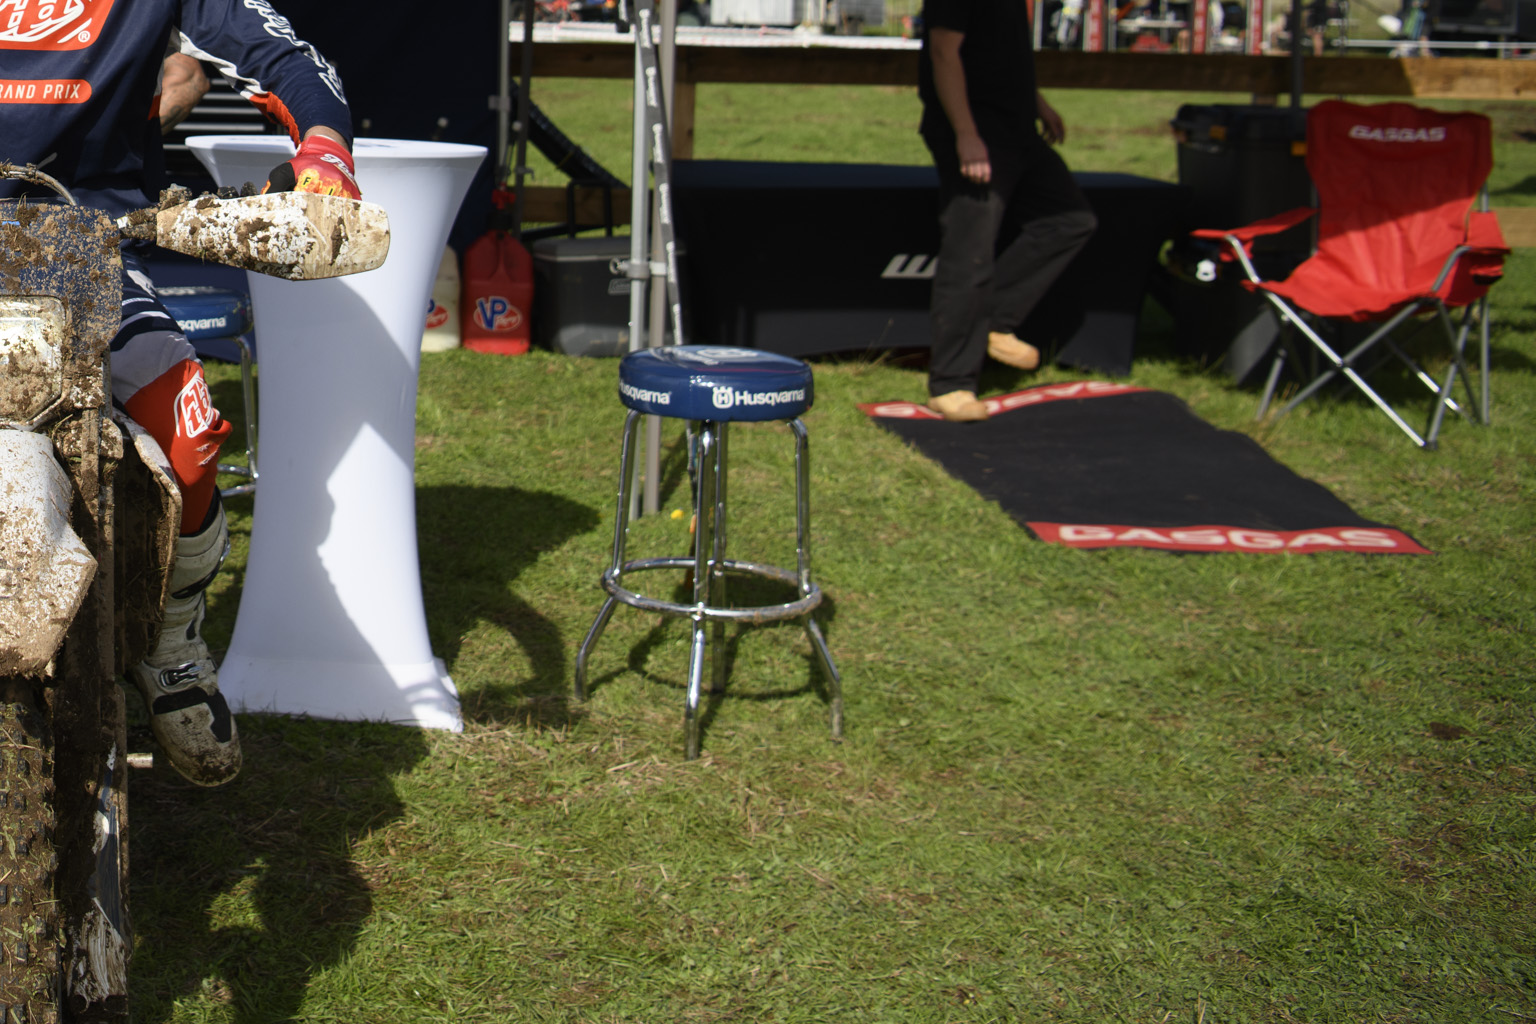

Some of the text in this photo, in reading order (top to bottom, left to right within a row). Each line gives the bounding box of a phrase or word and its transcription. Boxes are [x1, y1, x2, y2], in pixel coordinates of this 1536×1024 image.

[43, 84, 81, 99] PRIX
[1348, 124, 1446, 142] GASGAS
[477, 297, 509, 330] VP
[735, 389, 805, 406] Husqvarna
[1058, 524, 1397, 549] GASGAS
